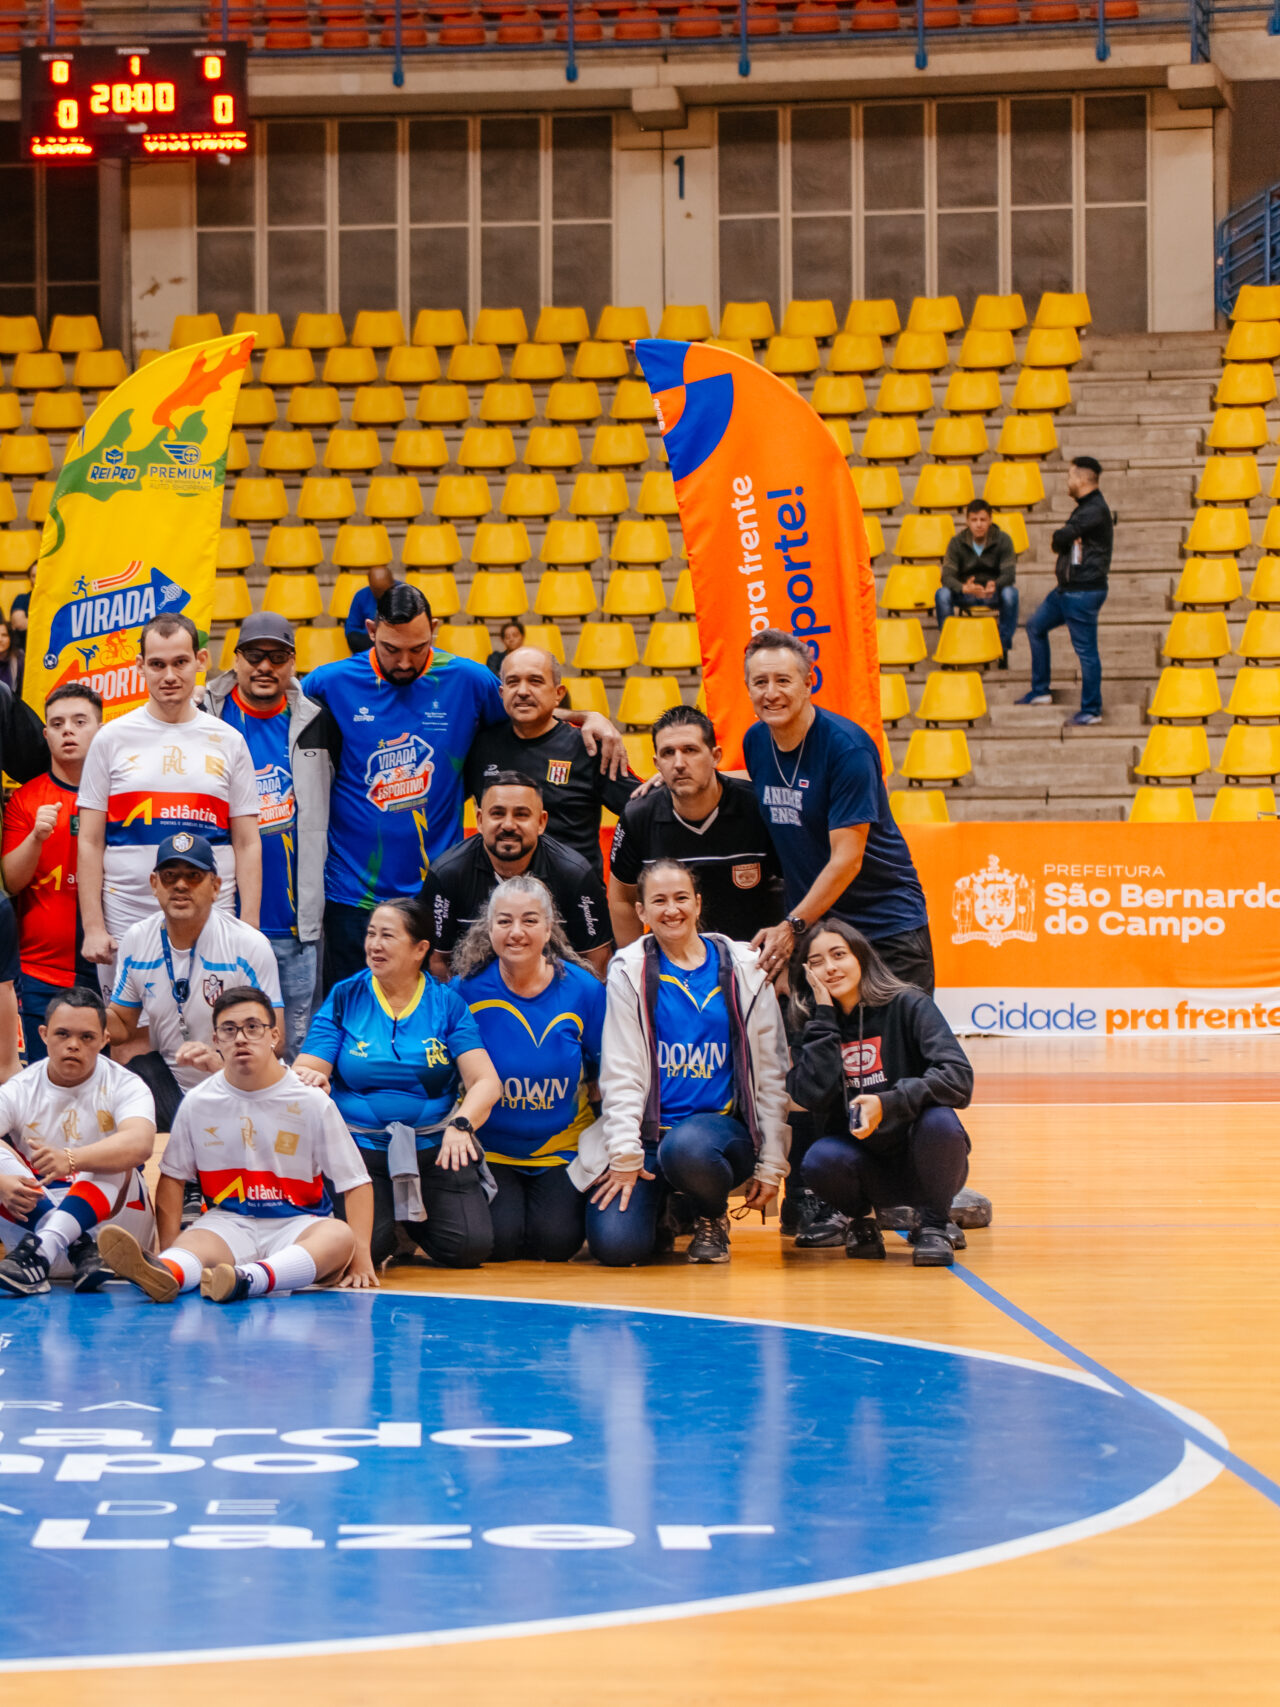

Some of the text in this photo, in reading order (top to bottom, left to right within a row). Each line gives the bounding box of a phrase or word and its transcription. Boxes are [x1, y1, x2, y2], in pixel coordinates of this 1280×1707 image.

[51, 60, 70, 84] 0
[129, 56, 141, 76] 1
[203, 57, 222, 79] 0
[90, 82, 176, 114] 20:00
[212, 95, 234, 124] 0
[57, 99, 79, 129] 0
[673, 155, 685, 200] 1
[90, 466, 111, 481] REI
[149, 465, 213, 481] PREMIUM
[731, 475, 763, 576] frente
[71, 586, 157, 639] VIRADA
[378, 746, 418, 770] VIRADA
[256, 777, 281, 795] RADA
[377, 776, 425, 800] ESPORTIVA
[1043, 864, 1166, 878] PREFEITURA
[1044, 881, 1280, 909] São Bernardo
[1044, 908, 1226, 943] do Campo
[971, 1000, 1280, 1035] Cidade pra frente
[658, 1040, 727, 1070] DOWN
[502, 1076, 569, 1101] OWN
[96, 1499, 280, 1515] DE
[31, 1518, 776, 1550] Lazer
